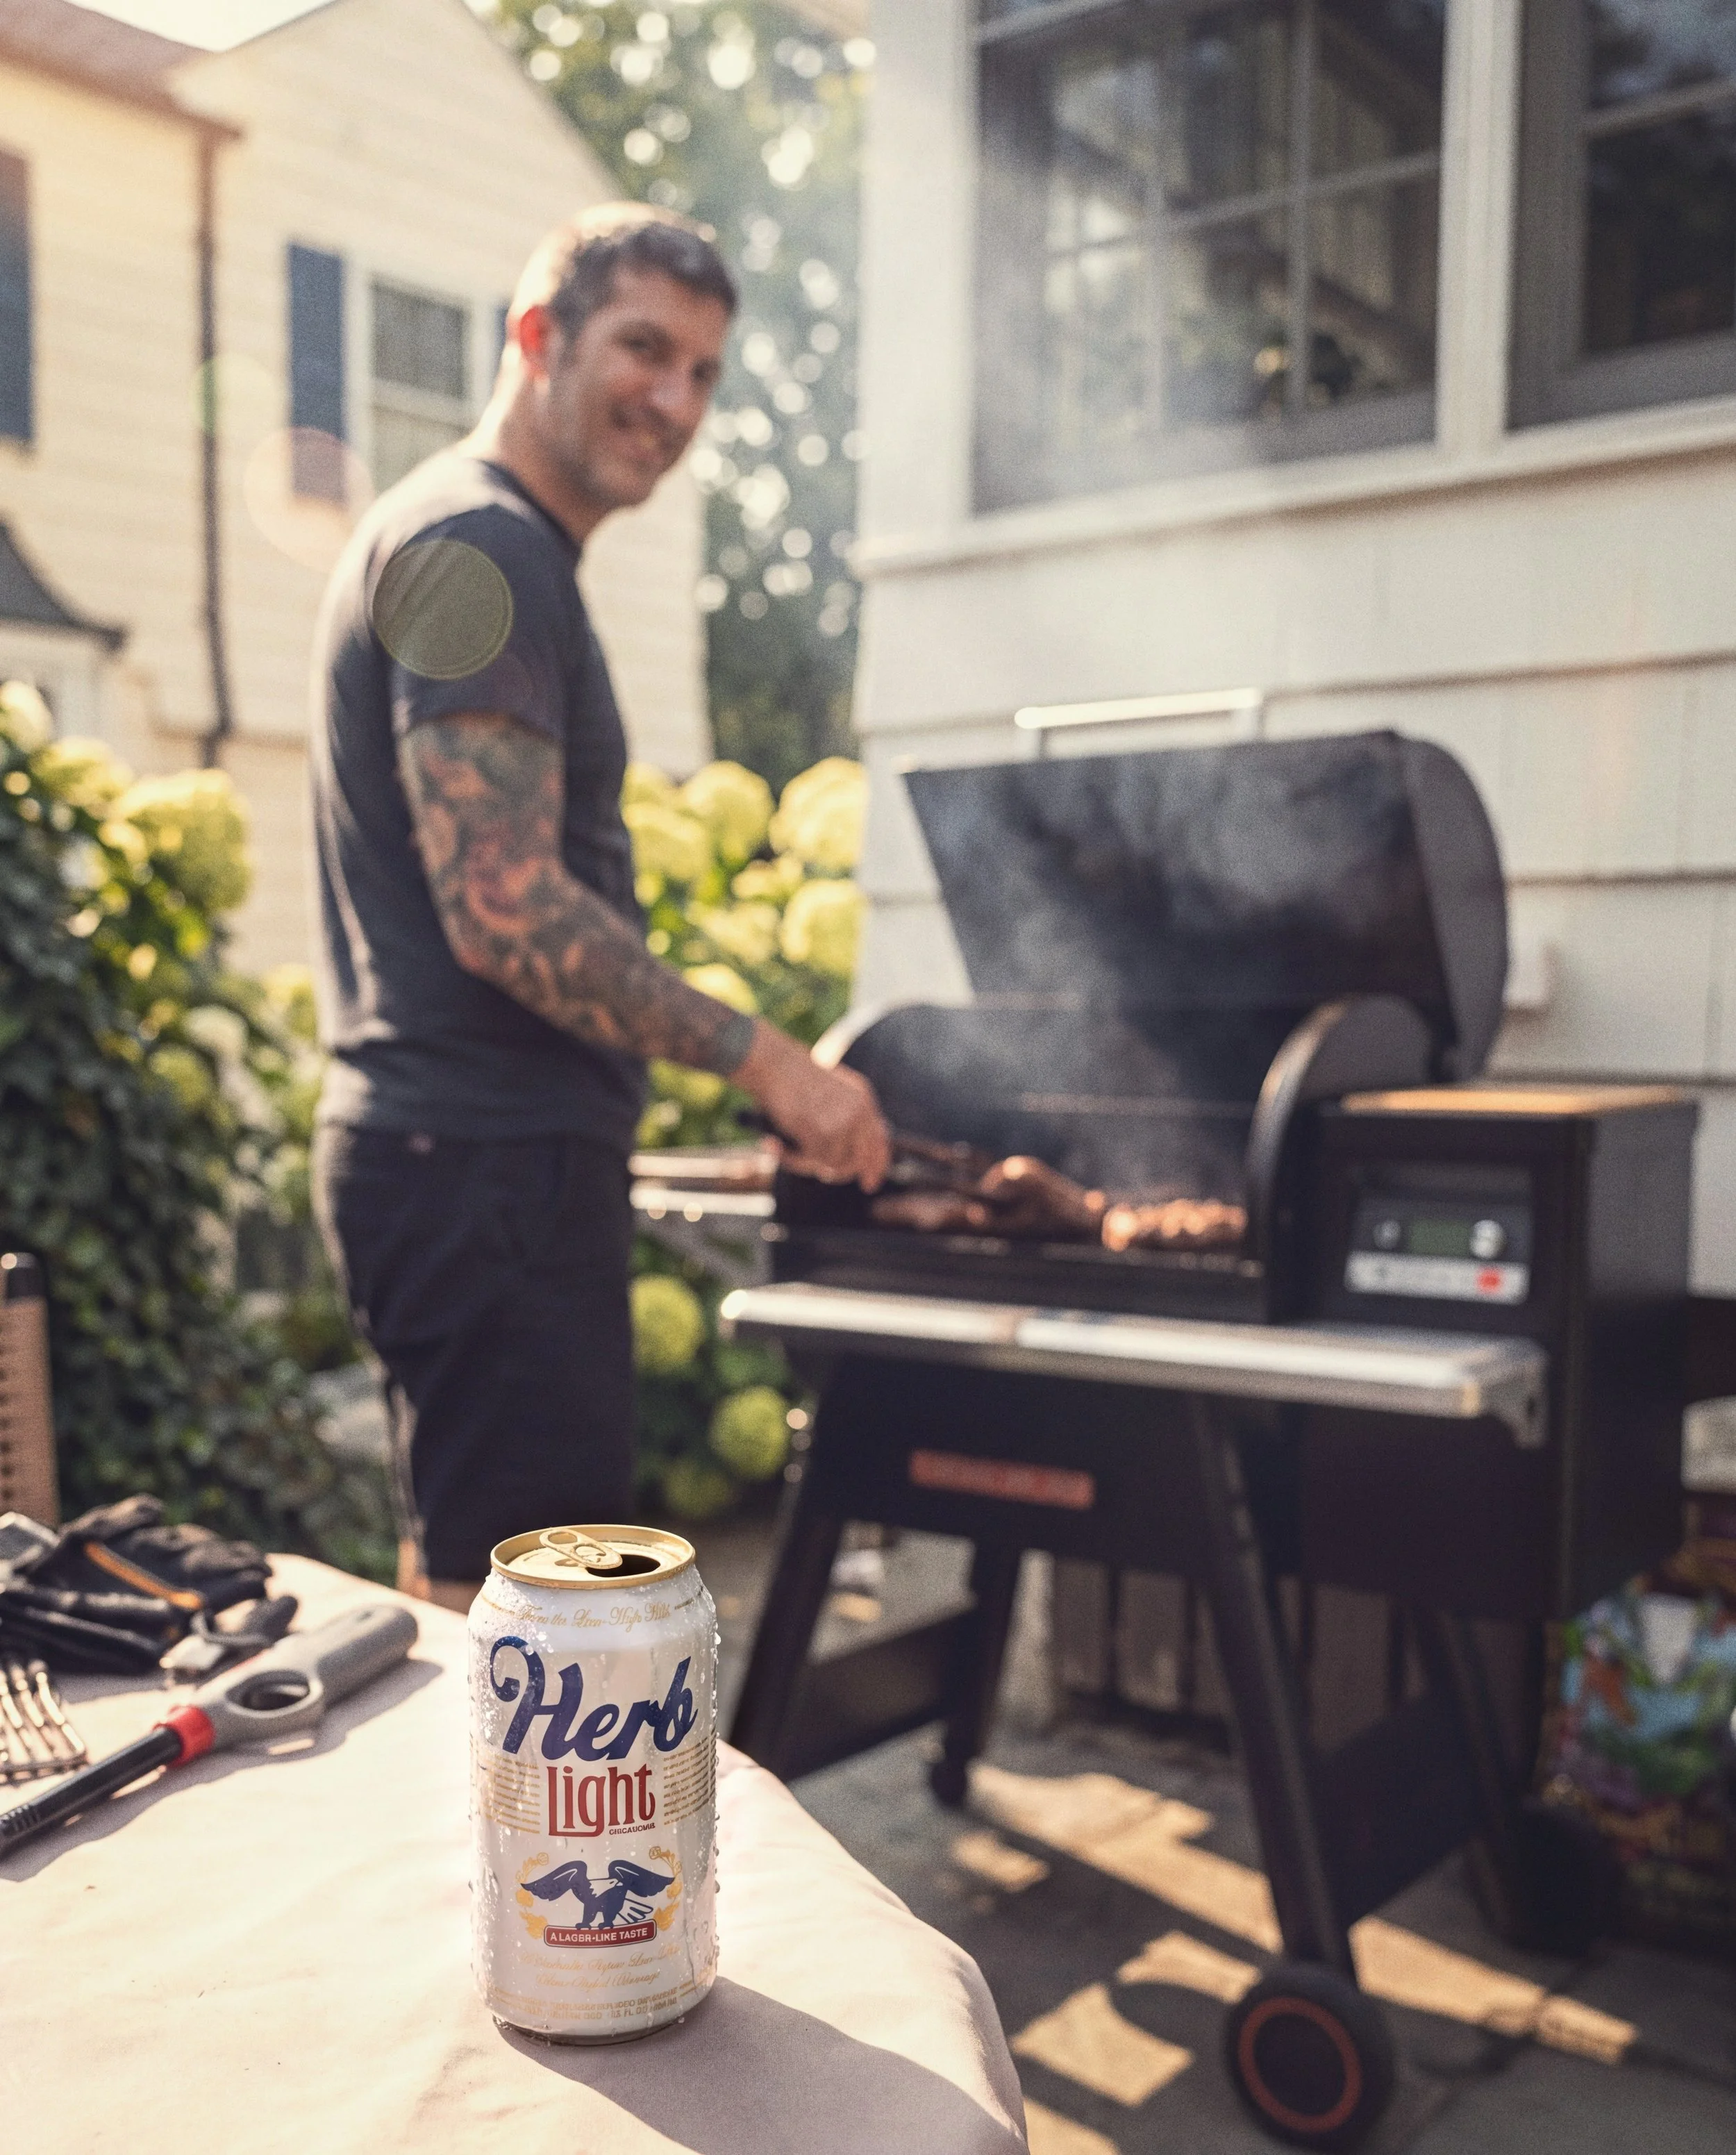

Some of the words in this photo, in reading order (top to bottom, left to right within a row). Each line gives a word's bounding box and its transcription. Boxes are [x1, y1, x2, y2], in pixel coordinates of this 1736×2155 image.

[490, 1636, 699, 1761] Herb
[546, 1763, 656, 1837] Light
[550, 1932, 557, 1942] A
[619, 1927, 648, 1940] TASTE
